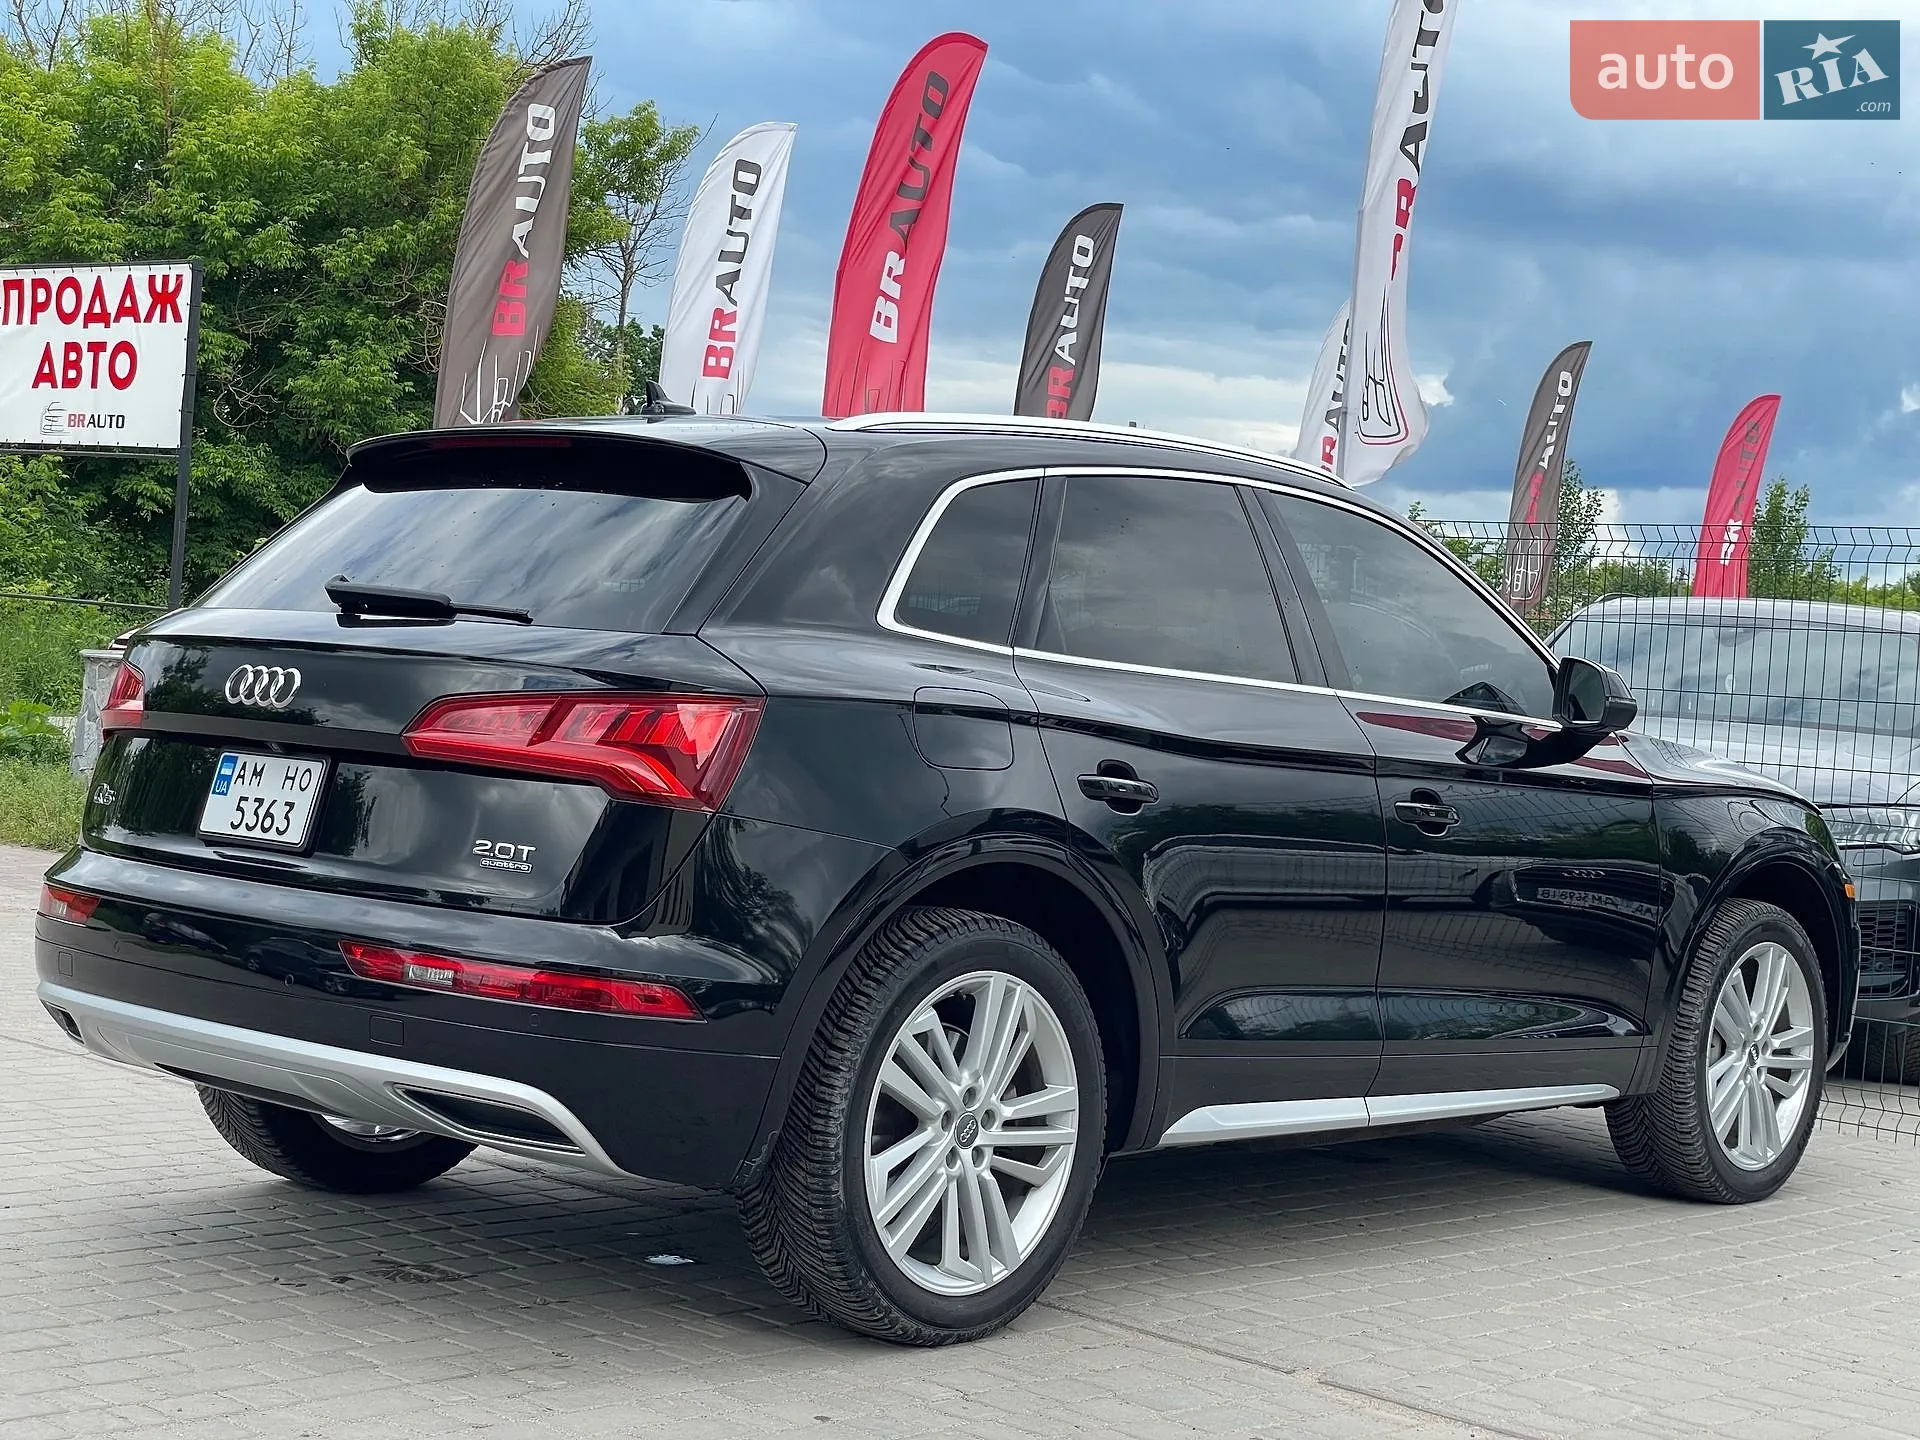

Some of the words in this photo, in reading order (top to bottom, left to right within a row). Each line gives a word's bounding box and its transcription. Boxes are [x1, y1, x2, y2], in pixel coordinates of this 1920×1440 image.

[492, 103, 556, 336] BRAUTO
[870, 70, 949, 344] BRAUTO
[702, 158, 762, 380] BRAUTO
[2, 274, 184, 329] ПРОДАЖ
[31, 340, 138, 390] АВТО
[67, 413, 126, 429] BRAUTO
[215, 780, 227, 793] UA
[234, 761, 266, 787] AM
[282, 766, 312, 792] HO
[230, 796, 296, 836] 5363
[472, 839, 537, 862] 2.0T
[481, 859, 530, 871] quattro
